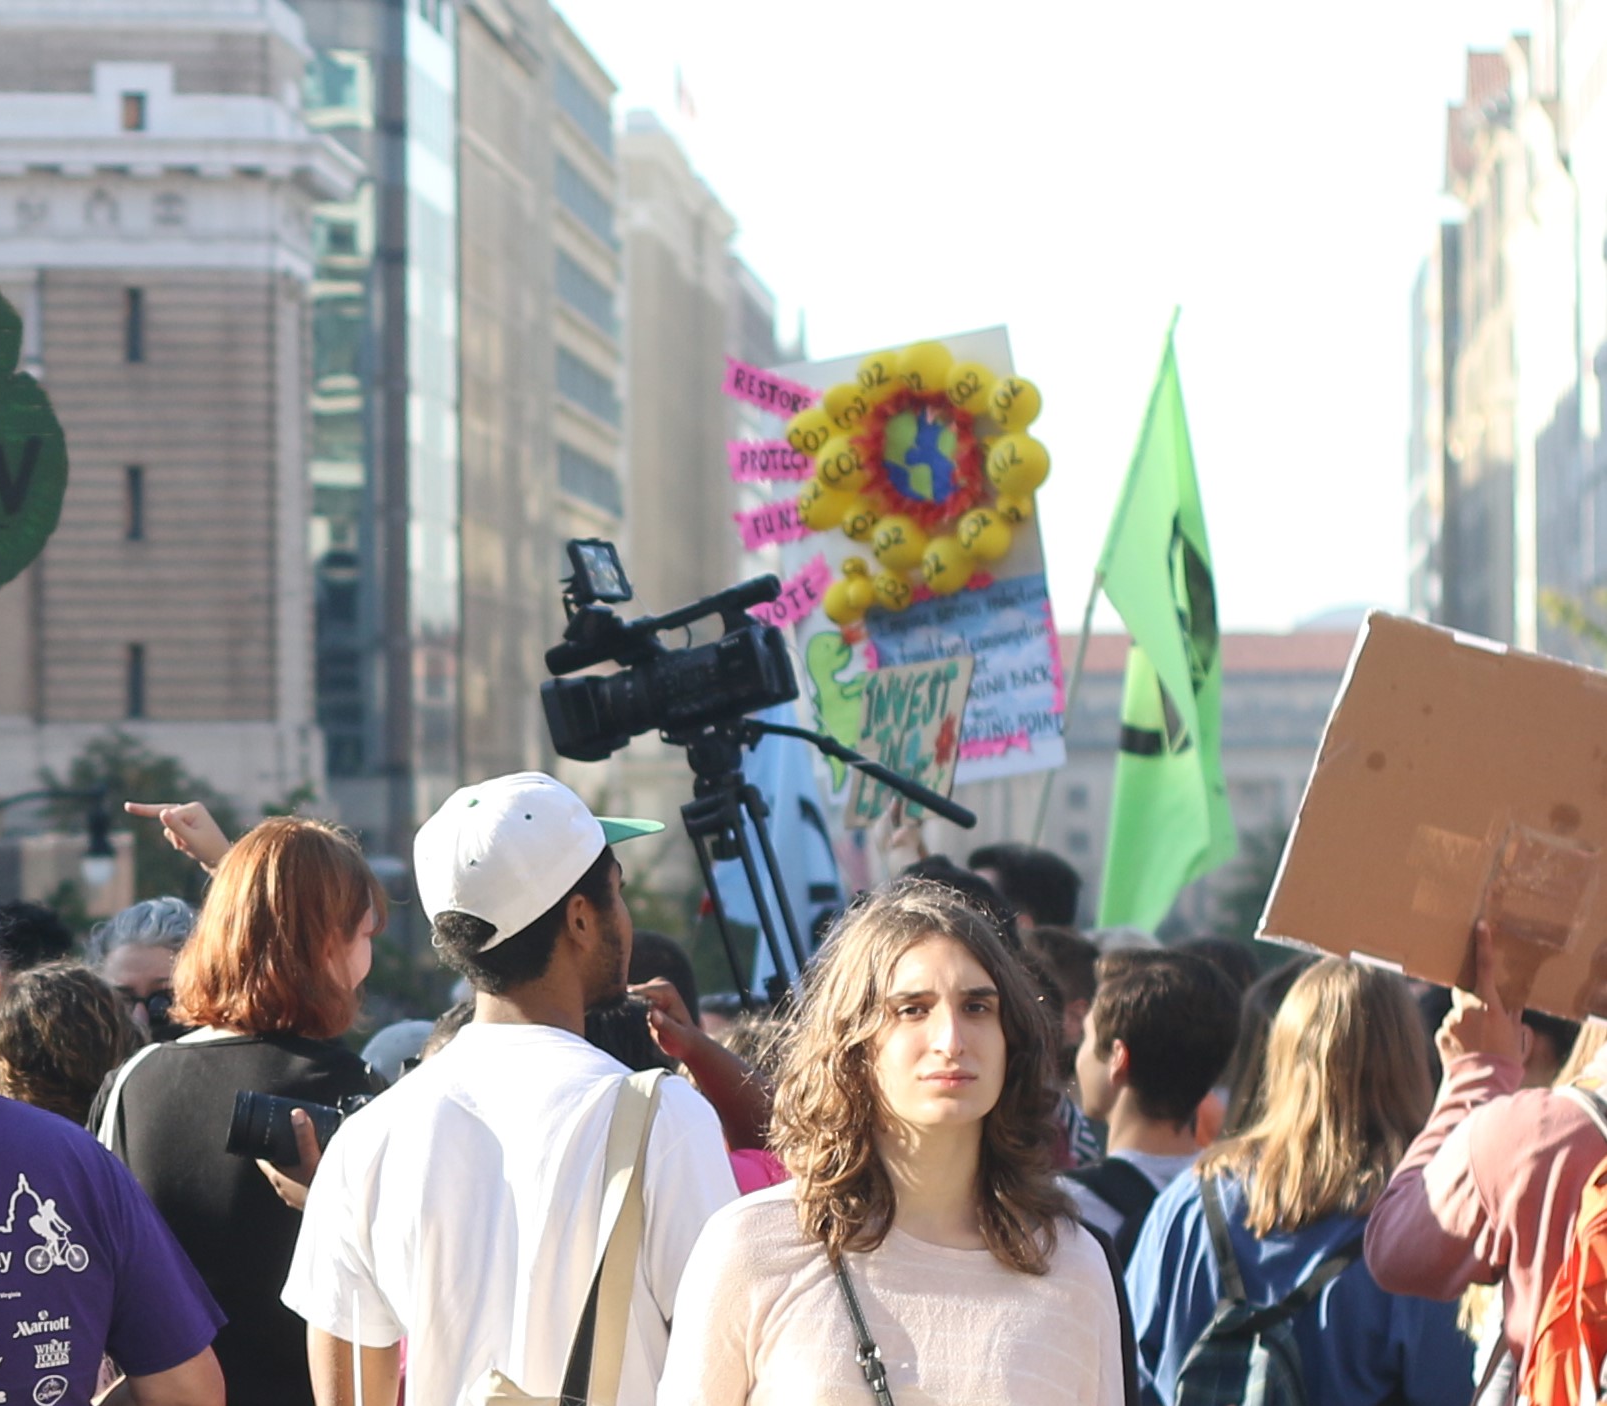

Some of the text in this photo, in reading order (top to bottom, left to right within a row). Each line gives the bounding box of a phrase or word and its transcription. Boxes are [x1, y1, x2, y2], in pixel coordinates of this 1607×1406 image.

[13, 1314, 71, 1339] Marriott
[34, 1340, 71, 1354] WHOLE
[36, 1352, 69, 1365] FOODS
